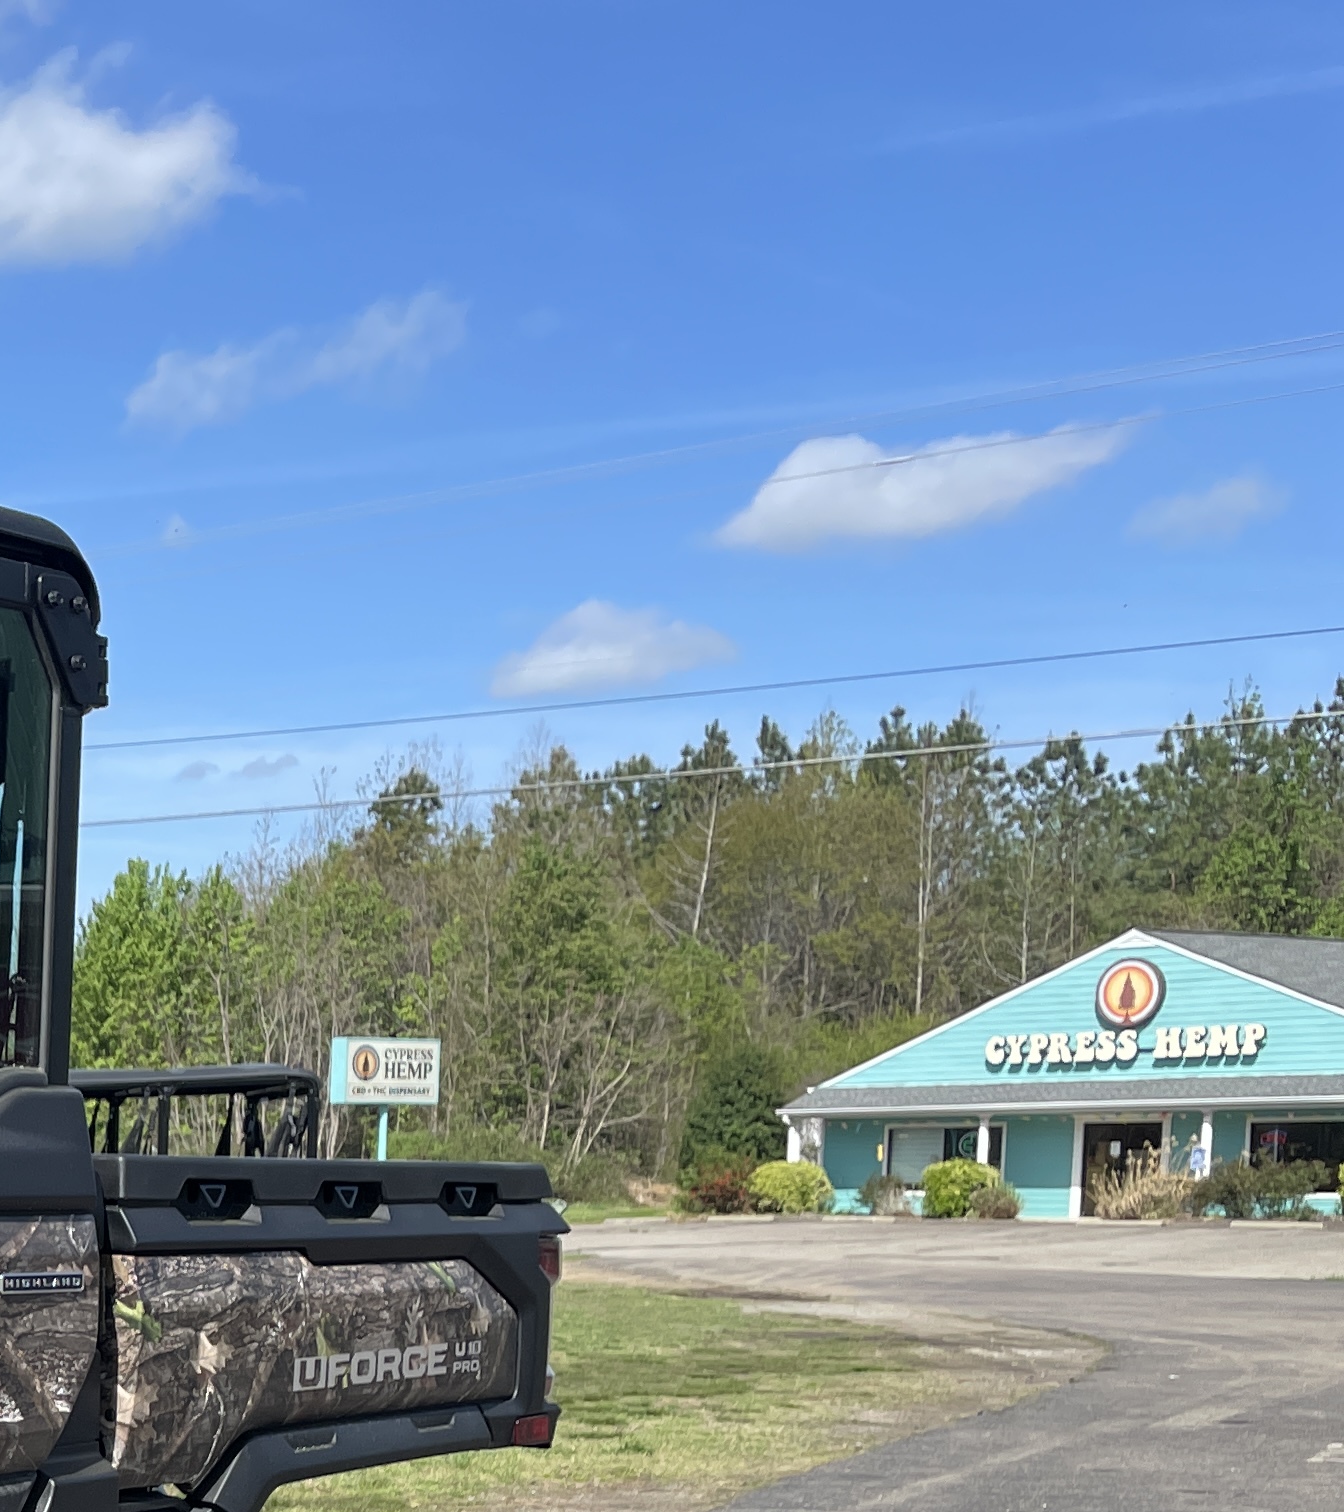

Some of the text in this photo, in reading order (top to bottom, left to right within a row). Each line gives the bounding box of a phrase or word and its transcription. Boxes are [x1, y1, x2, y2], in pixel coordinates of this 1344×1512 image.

[985, 1024, 1266, 1065] CYPRESS HEMP
[384, 1048, 434, 1060] CYPRESS
[384, 1061, 433, 1080] HEMP
[4, 1276, 82, 1289] HIGHLAND
[452, 1359, 481, 1374] PRO
